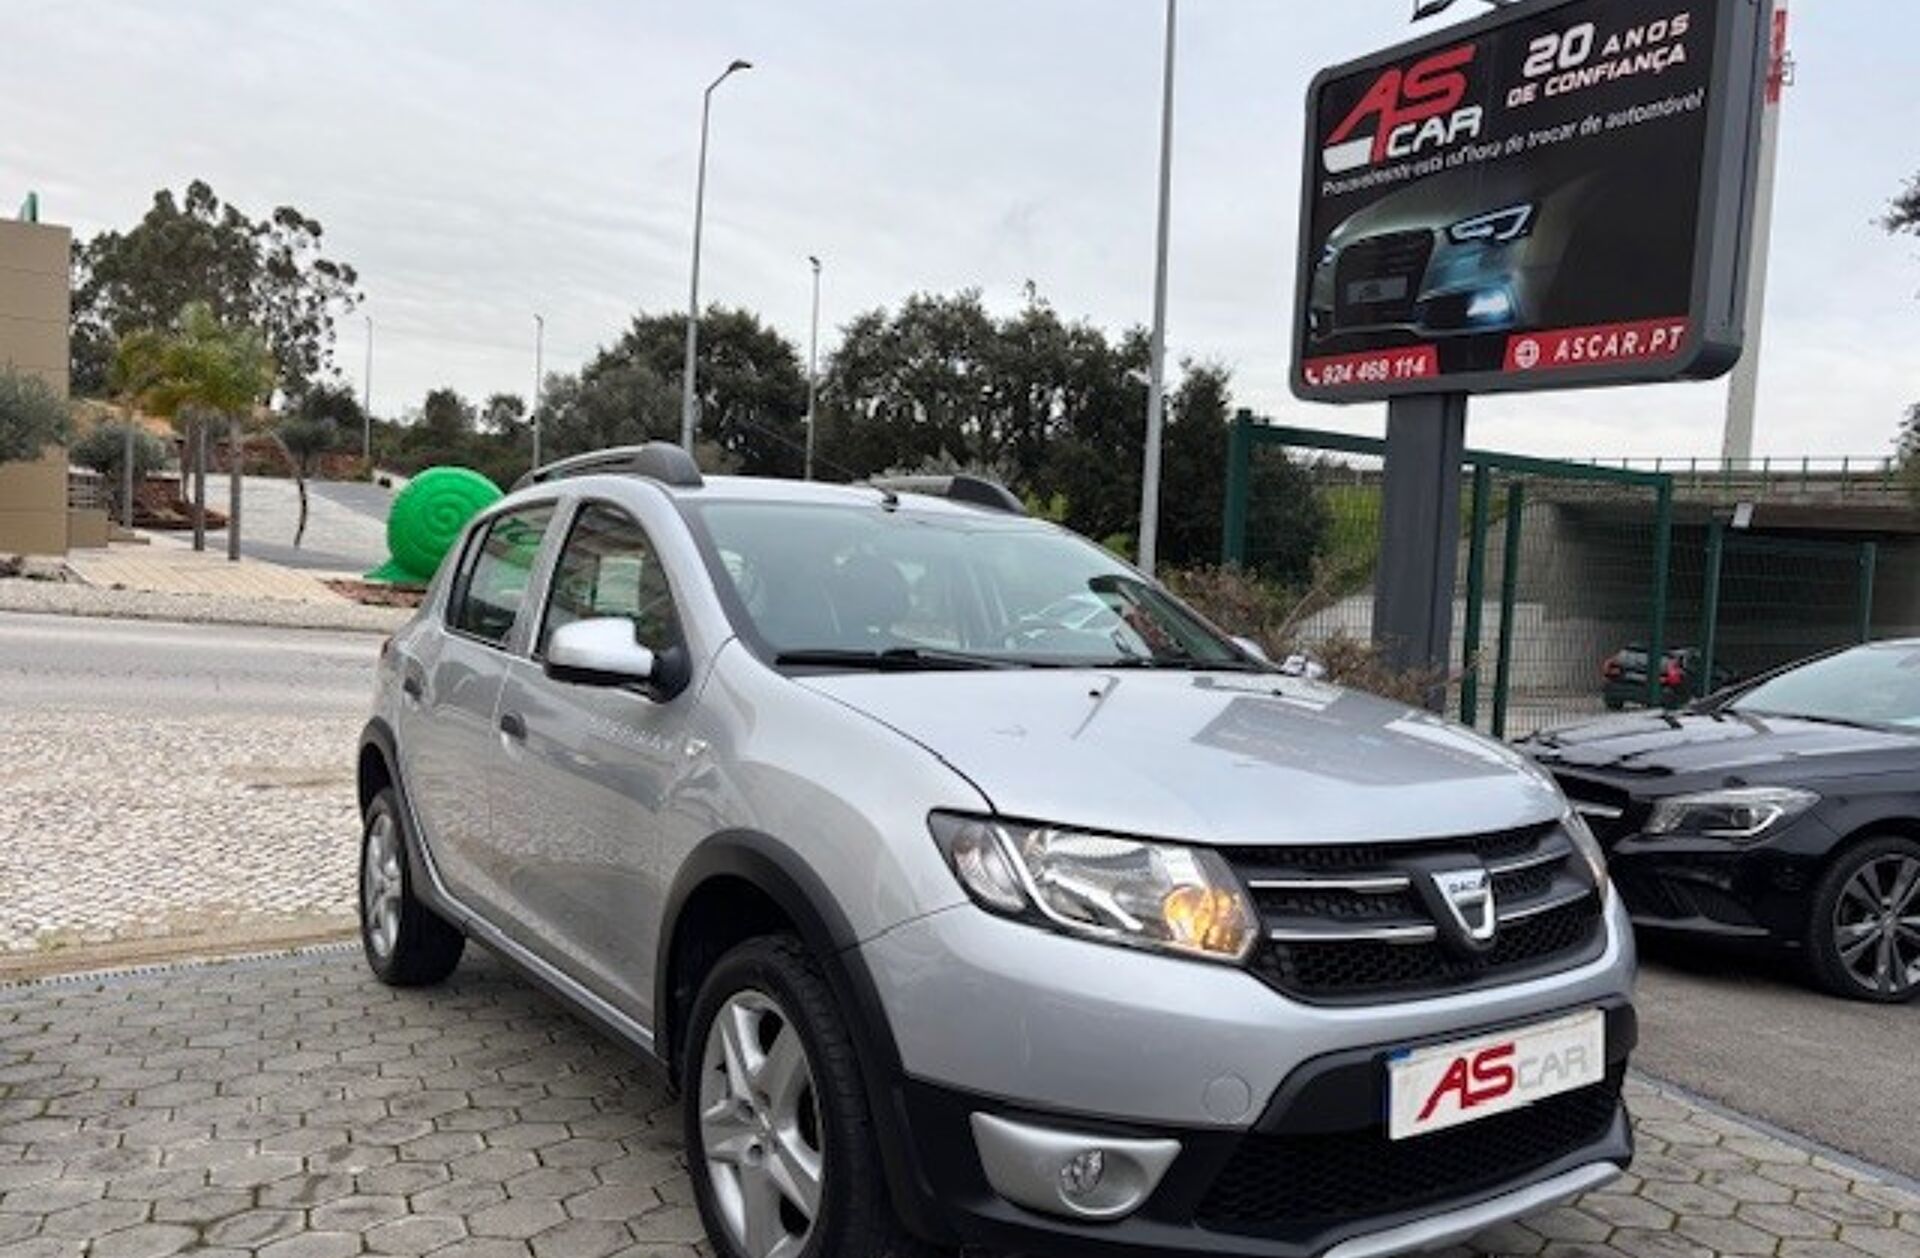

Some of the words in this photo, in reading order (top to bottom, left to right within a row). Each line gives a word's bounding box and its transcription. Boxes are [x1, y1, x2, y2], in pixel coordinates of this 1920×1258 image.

[1523, 22, 1595, 78] 20
[1602, 12, 1690, 57] ANOS
[1325, 44, 1477, 167] AS
[1506, 83, 1539, 109] DE
[1544, 43, 1687, 97] CONFIANÇA
[1387, 105, 1482, 158] CAR
[1394, 355, 1426, 378] 114
[1553, 325, 1684, 362] ASCAR.PT
